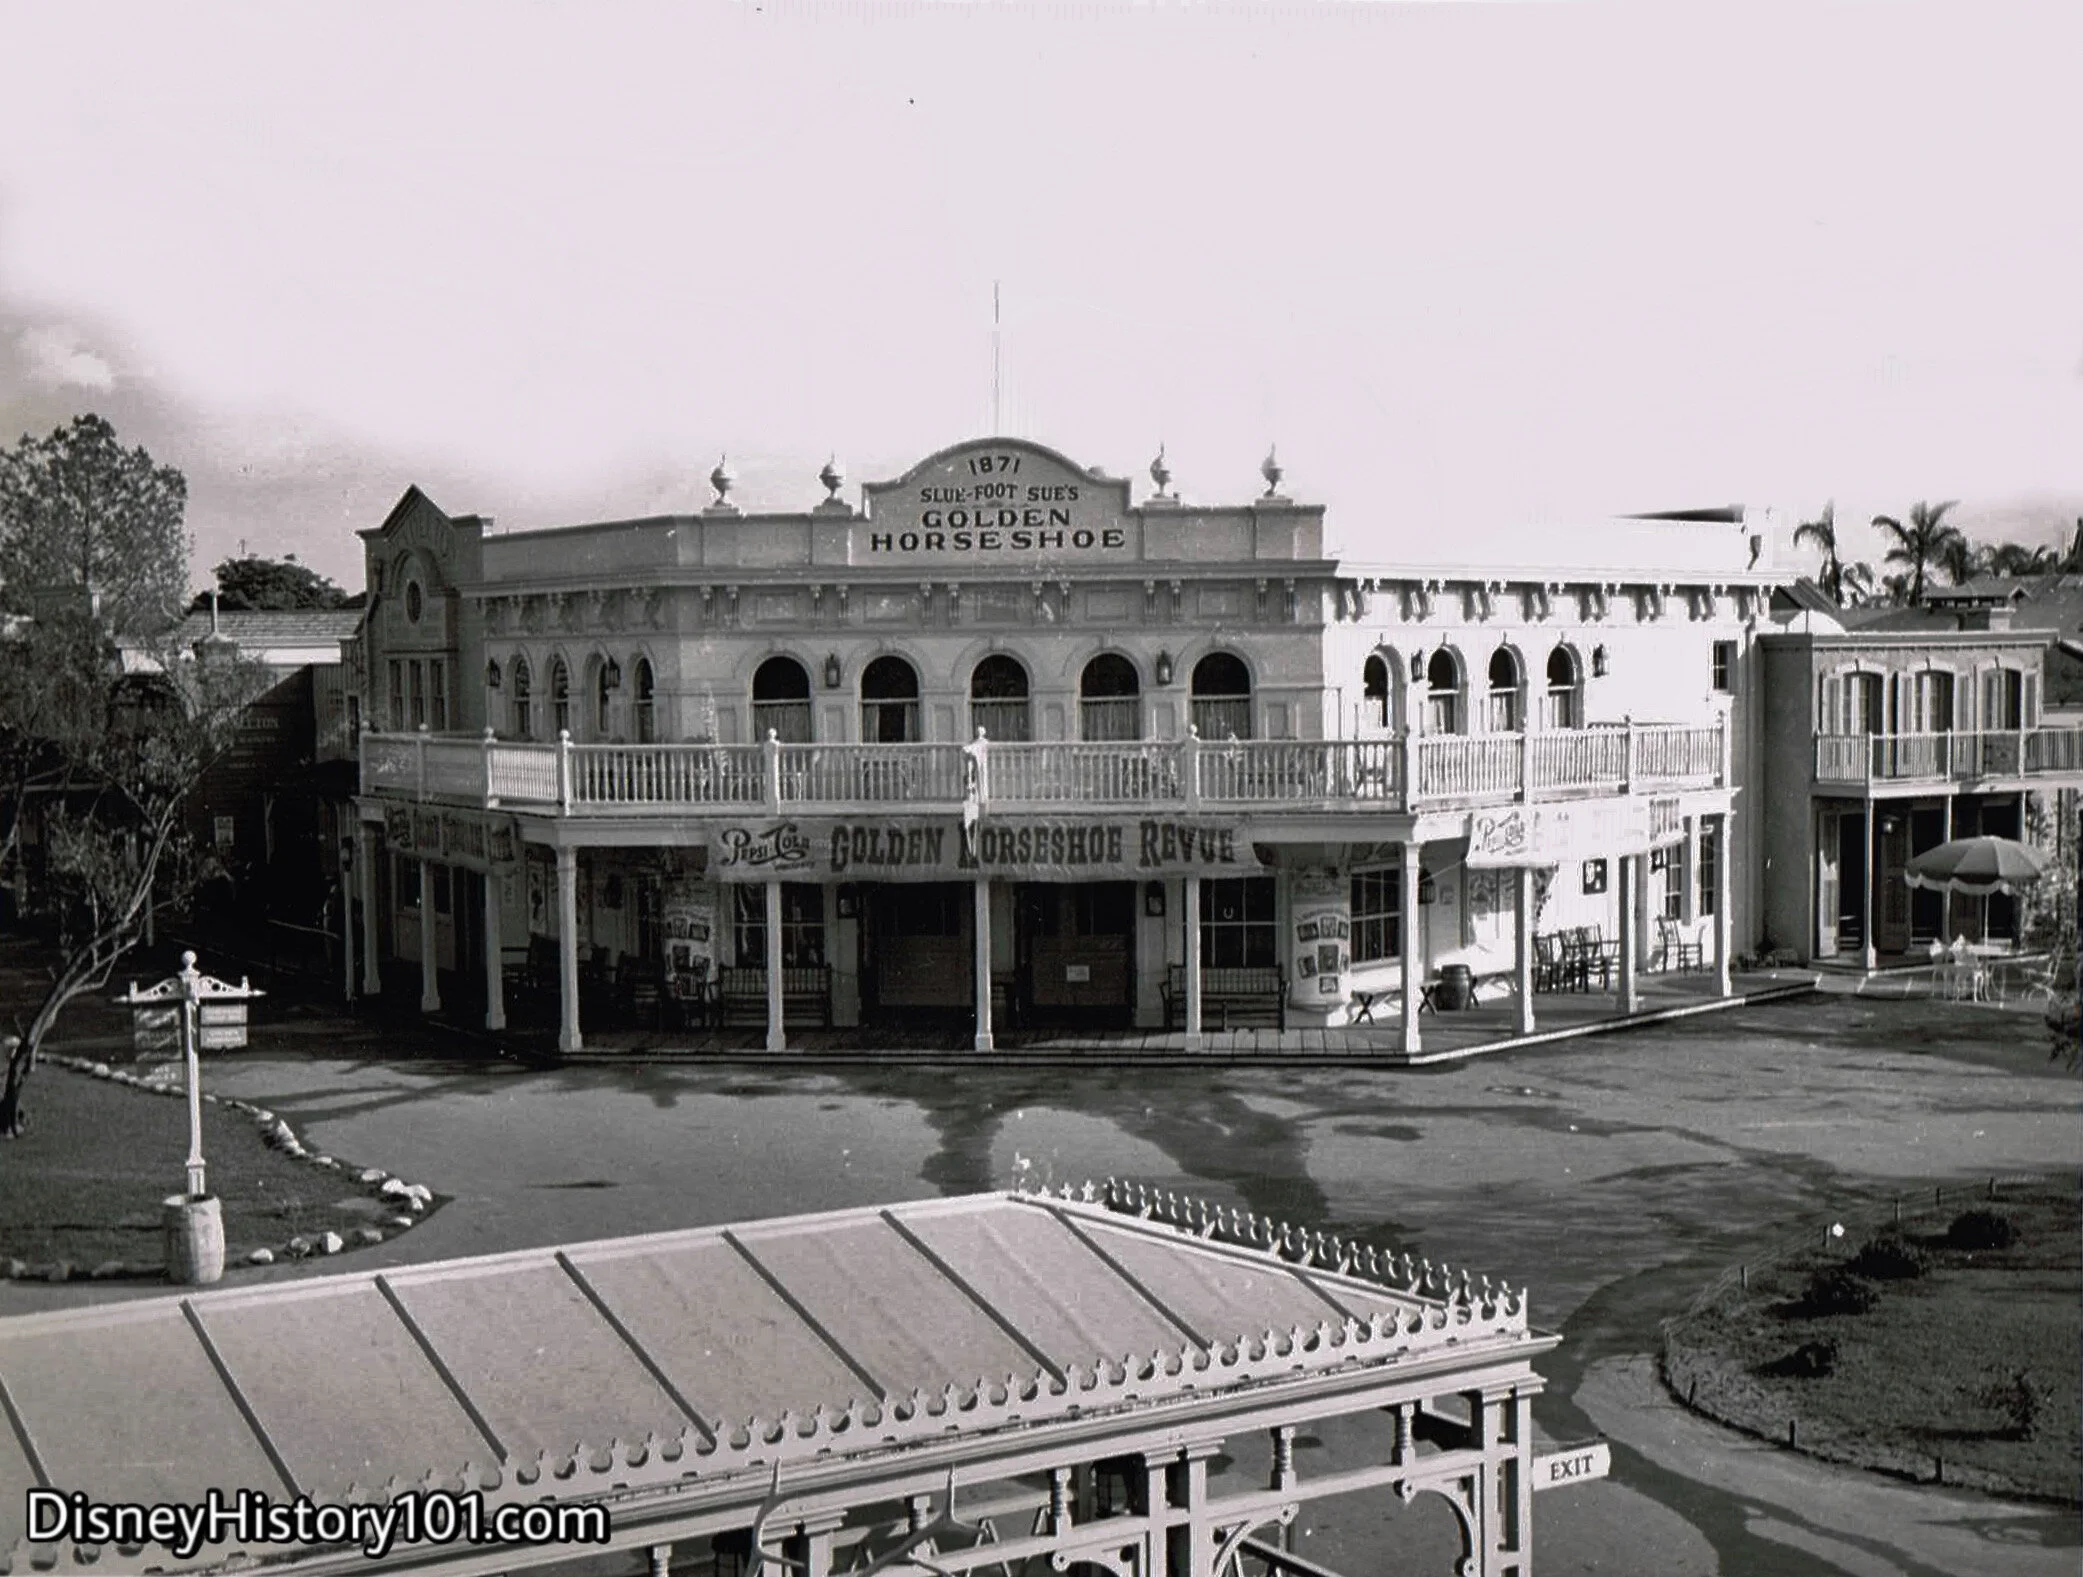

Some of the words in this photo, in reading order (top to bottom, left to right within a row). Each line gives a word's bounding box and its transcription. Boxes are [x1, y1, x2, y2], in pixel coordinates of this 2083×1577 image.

[968, 455, 1021, 477] 1871
[1027, 482, 1079, 502] SUE'S
[921, 508, 1071, 529] GOLDEN
[870, 528, 1126, 552] HORSESHOE
[829, 824, 945, 873] GOLDEN
[1139, 820, 1237, 868] REVUE
[1550, 1453, 1594, 1481] EXIT
